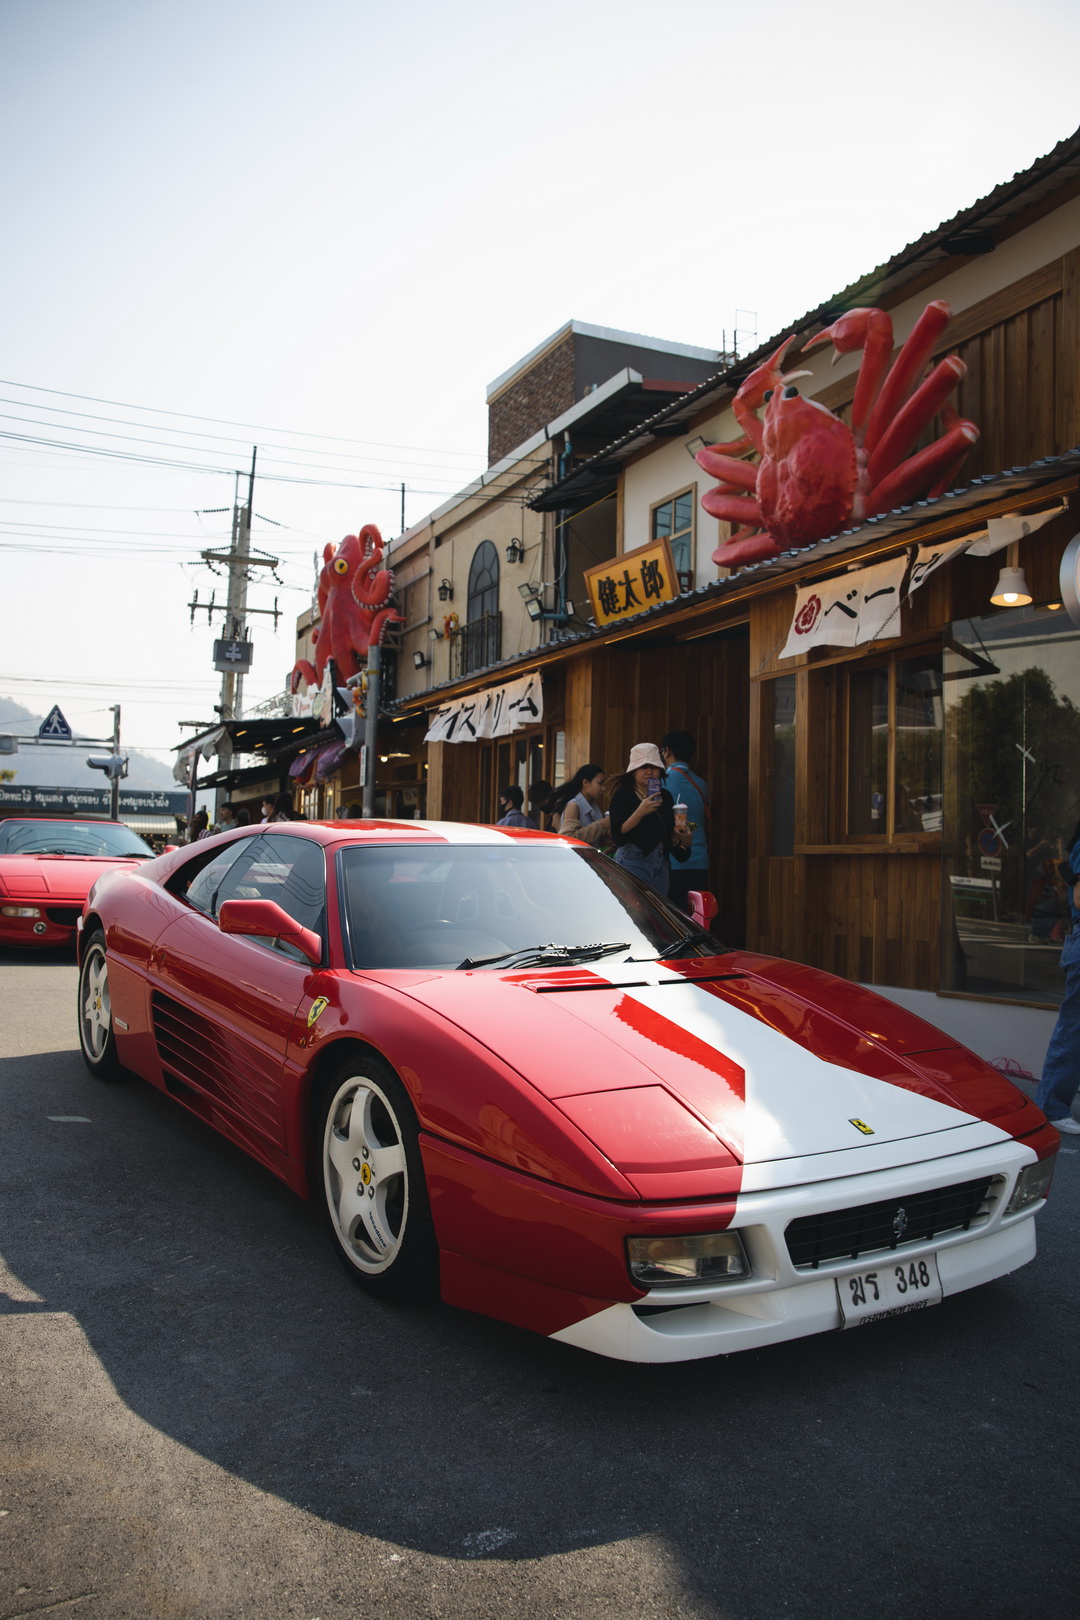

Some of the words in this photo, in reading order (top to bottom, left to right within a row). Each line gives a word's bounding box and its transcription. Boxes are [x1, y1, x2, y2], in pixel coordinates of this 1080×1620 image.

[597, 559, 664, 617] 健太郎
[369, 1211, 387, 1248] speedline
[895, 1261, 930, 1293] 348
[859, 1298, 929, 1325] กรงเทพมหานคร
